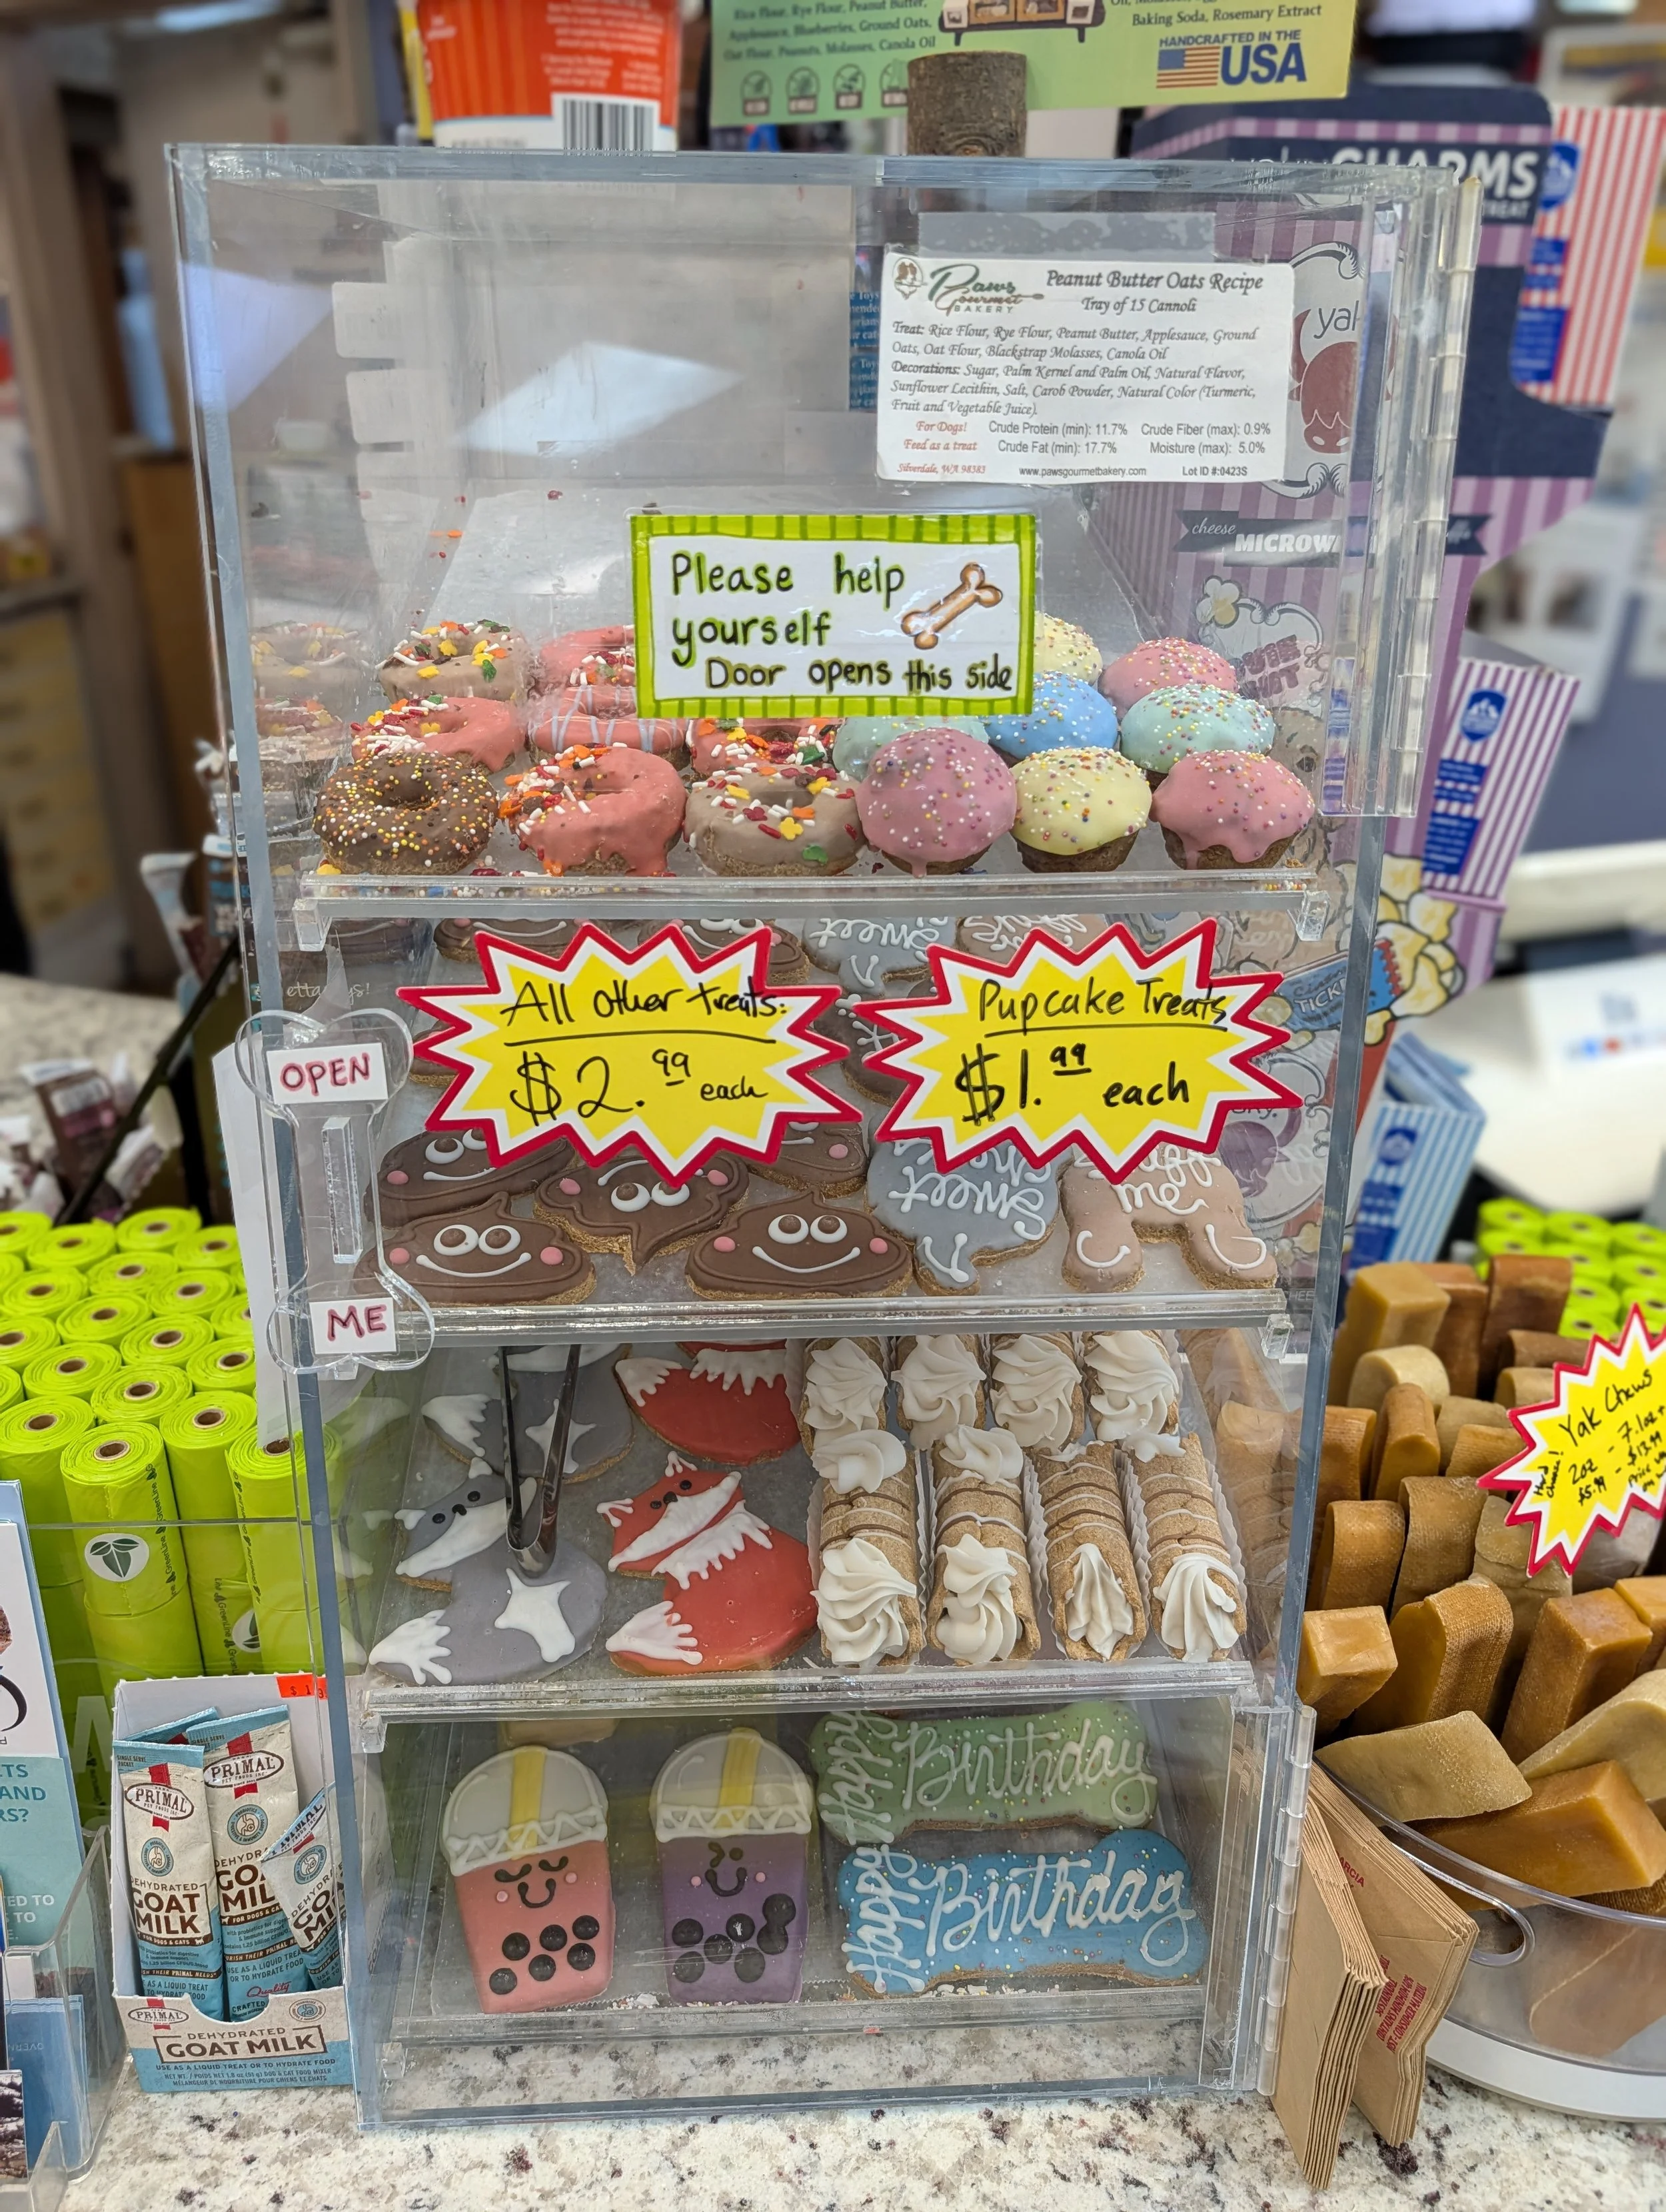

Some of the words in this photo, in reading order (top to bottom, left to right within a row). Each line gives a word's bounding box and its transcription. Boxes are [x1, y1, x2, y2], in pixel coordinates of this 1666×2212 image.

[1132, 14, 1173, 27] Baking
[1213, 7, 1273, 23] Rosemary
[1278, 5, 1322, 17] Extract
[1160, 33, 1255, 47] HANDCRAFTED
[1259, 31, 1271, 41] IN
[1275, 29, 1301, 41] THE
[1221, 42, 1307, 86] USA
[928, 264, 1016, 300] Paws
[1047, 270, 1103, 286] Peanut
[1106, 271, 1164, 288] Butter
[1166, 272, 1205, 289] Oats
[1210, 272, 1263, 296] Recipe
[1081, 296, 1110, 315] Tray
[1113, 296, 1130, 315] of
[1130, 298, 1146, 311] 15
[1148, 297, 1197, 313] Cannoli
[892, 321, 925, 335] Treat:
[928, 324, 953, 338] Rice
[956, 323, 989, 339] Flour,
[994, 326, 1015, 340] Rye
[1018, 325, 1052, 340] Flour,
[1056, 326, 1097, 338] Peanut
[1100, 328, 1139, 342] Butter,
[1141, 327, 1208, 342] Applesauce,
[1214, 327, 1258, 343] Ground
[892, 341, 919, 356] Oats,
[924, 343, 945, 354] Oat
[948, 342, 982, 358] Flour,
[986, 344, 1047, 360] Blackstrap
[1050, 345, 1102, 360] Molasses,
[1107, 346, 1146, 360] Canola
[1149, 346, 1170, 360] Oil
[892, 360, 961, 375] Decorations:
[964, 364, 999, 379] Sugar,
[1003, 363, 1032, 376] Palm
[1035, 364, 1074, 379] Kernel
[1075, 364, 1098, 377] and
[1099, 366, 1128, 378] Palm
[1131, 366, 1152, 380] Oil,
[1154, 365, 1203, 379] Natural
[1204, 365, 1245, 380] Flavor,
[890, 380, 949, 396] Sunflower
[951, 382, 1000, 396] Lecithin,
[1003, 382, 1028, 398] Salt,
[1033, 384, 1066, 398] Carob
[1068, 384, 1114, 398] Powder,
[1117, 385, 1165, 398] Natural
[1166, 384, 1197, 399] Color
[1199, 385, 1255, 400] (Turmeric,
[892, 399, 920, 411] Fruit
[923, 400, 946, 412] and
[948, 400, 1002, 416] Vegetable
[1003, 402, 1038, 418] Juice).
[916, 421, 936, 431] For
[937, 422, 967, 435] Dogs!
[989, 420, 1020, 434] Crude
[1023, 422, 1059, 434] Protein
[1062, 423, 1091, 438] (min):
[1096, 423, 1128, 435] 11.7%
[1141, 423, 1173, 435] Crude
[1177, 423, 1204, 435] Fiber
[1207, 423, 1240, 438] (max):
[1244, 422, 1271, 435] 0.9%
[904, 438, 929, 450] Feed
[953, 442, 977, 450] treat
[998, 440, 1028, 452] Crude
[1032, 441, 1048, 453] Fat
[1052, 442, 1080, 456] (min):
[1085, 442, 1117, 454] 17.7%
[1150, 442, 1195, 454] Moisture
[1199, 442, 1231, 456] (max):
[1239, 442, 1265, 454] 5.0%
[942, 464, 958, 474] WA
[962, 465, 986, 474] 98383
[1019, 466, 1146, 478] www.pawsgourmetbakery.com
[1183, 466, 1198, 476] Lot
[1200, 466, 1209, 476] ID
[1212, 466, 1248, 476] #:0423S
[1192, 517, 1236, 535] cheese
[672, 552, 793, 596] Please
[834, 552, 904, 610] help
[672, 611, 831, 667] yourself
[706, 657, 786, 690] Door
[808, 658, 892, 693] opens
[904, 659, 952, 695] this
[966, 654, 1012, 692] side
[500, 980, 574, 1027] All
[978, 976, 1124, 1036] Pupcake
[1136, 977, 1227, 1025] Treats
[280, 1052, 371, 1096] OPEN
[1102, 1061, 1190, 1107] each
[700, 1075, 768, 1101] each
[327, 1304, 388, 1342] ME
[1559, 1406, 1602, 1447] Yak
[1605, 1369, 1653, 1412] Chews
[211, 1756, 276, 1782] PRIMAL
[891, 1719, 1158, 1826] Birthday
[135, 1788, 187, 1814] PRIMAL
[1339, 1856, 1364, 1888] ARCIA
[133, 1888, 200, 1914] GOAT
[135, 1908, 201, 1934] MILK
[842, 1844, 926, 1993] Happy
[908, 1850, 1196, 1968] Birthday
[247, 1981, 292, 1997] Quality
[136, 2011, 183, 2019] PRIMAL
[232, 2001, 266, 2013] CRAFTED
[187, 2027, 286, 2040] DEHYDRATED
[166, 2041, 239, 2057] GOAT
[246, 2034, 317, 2054] MILK
